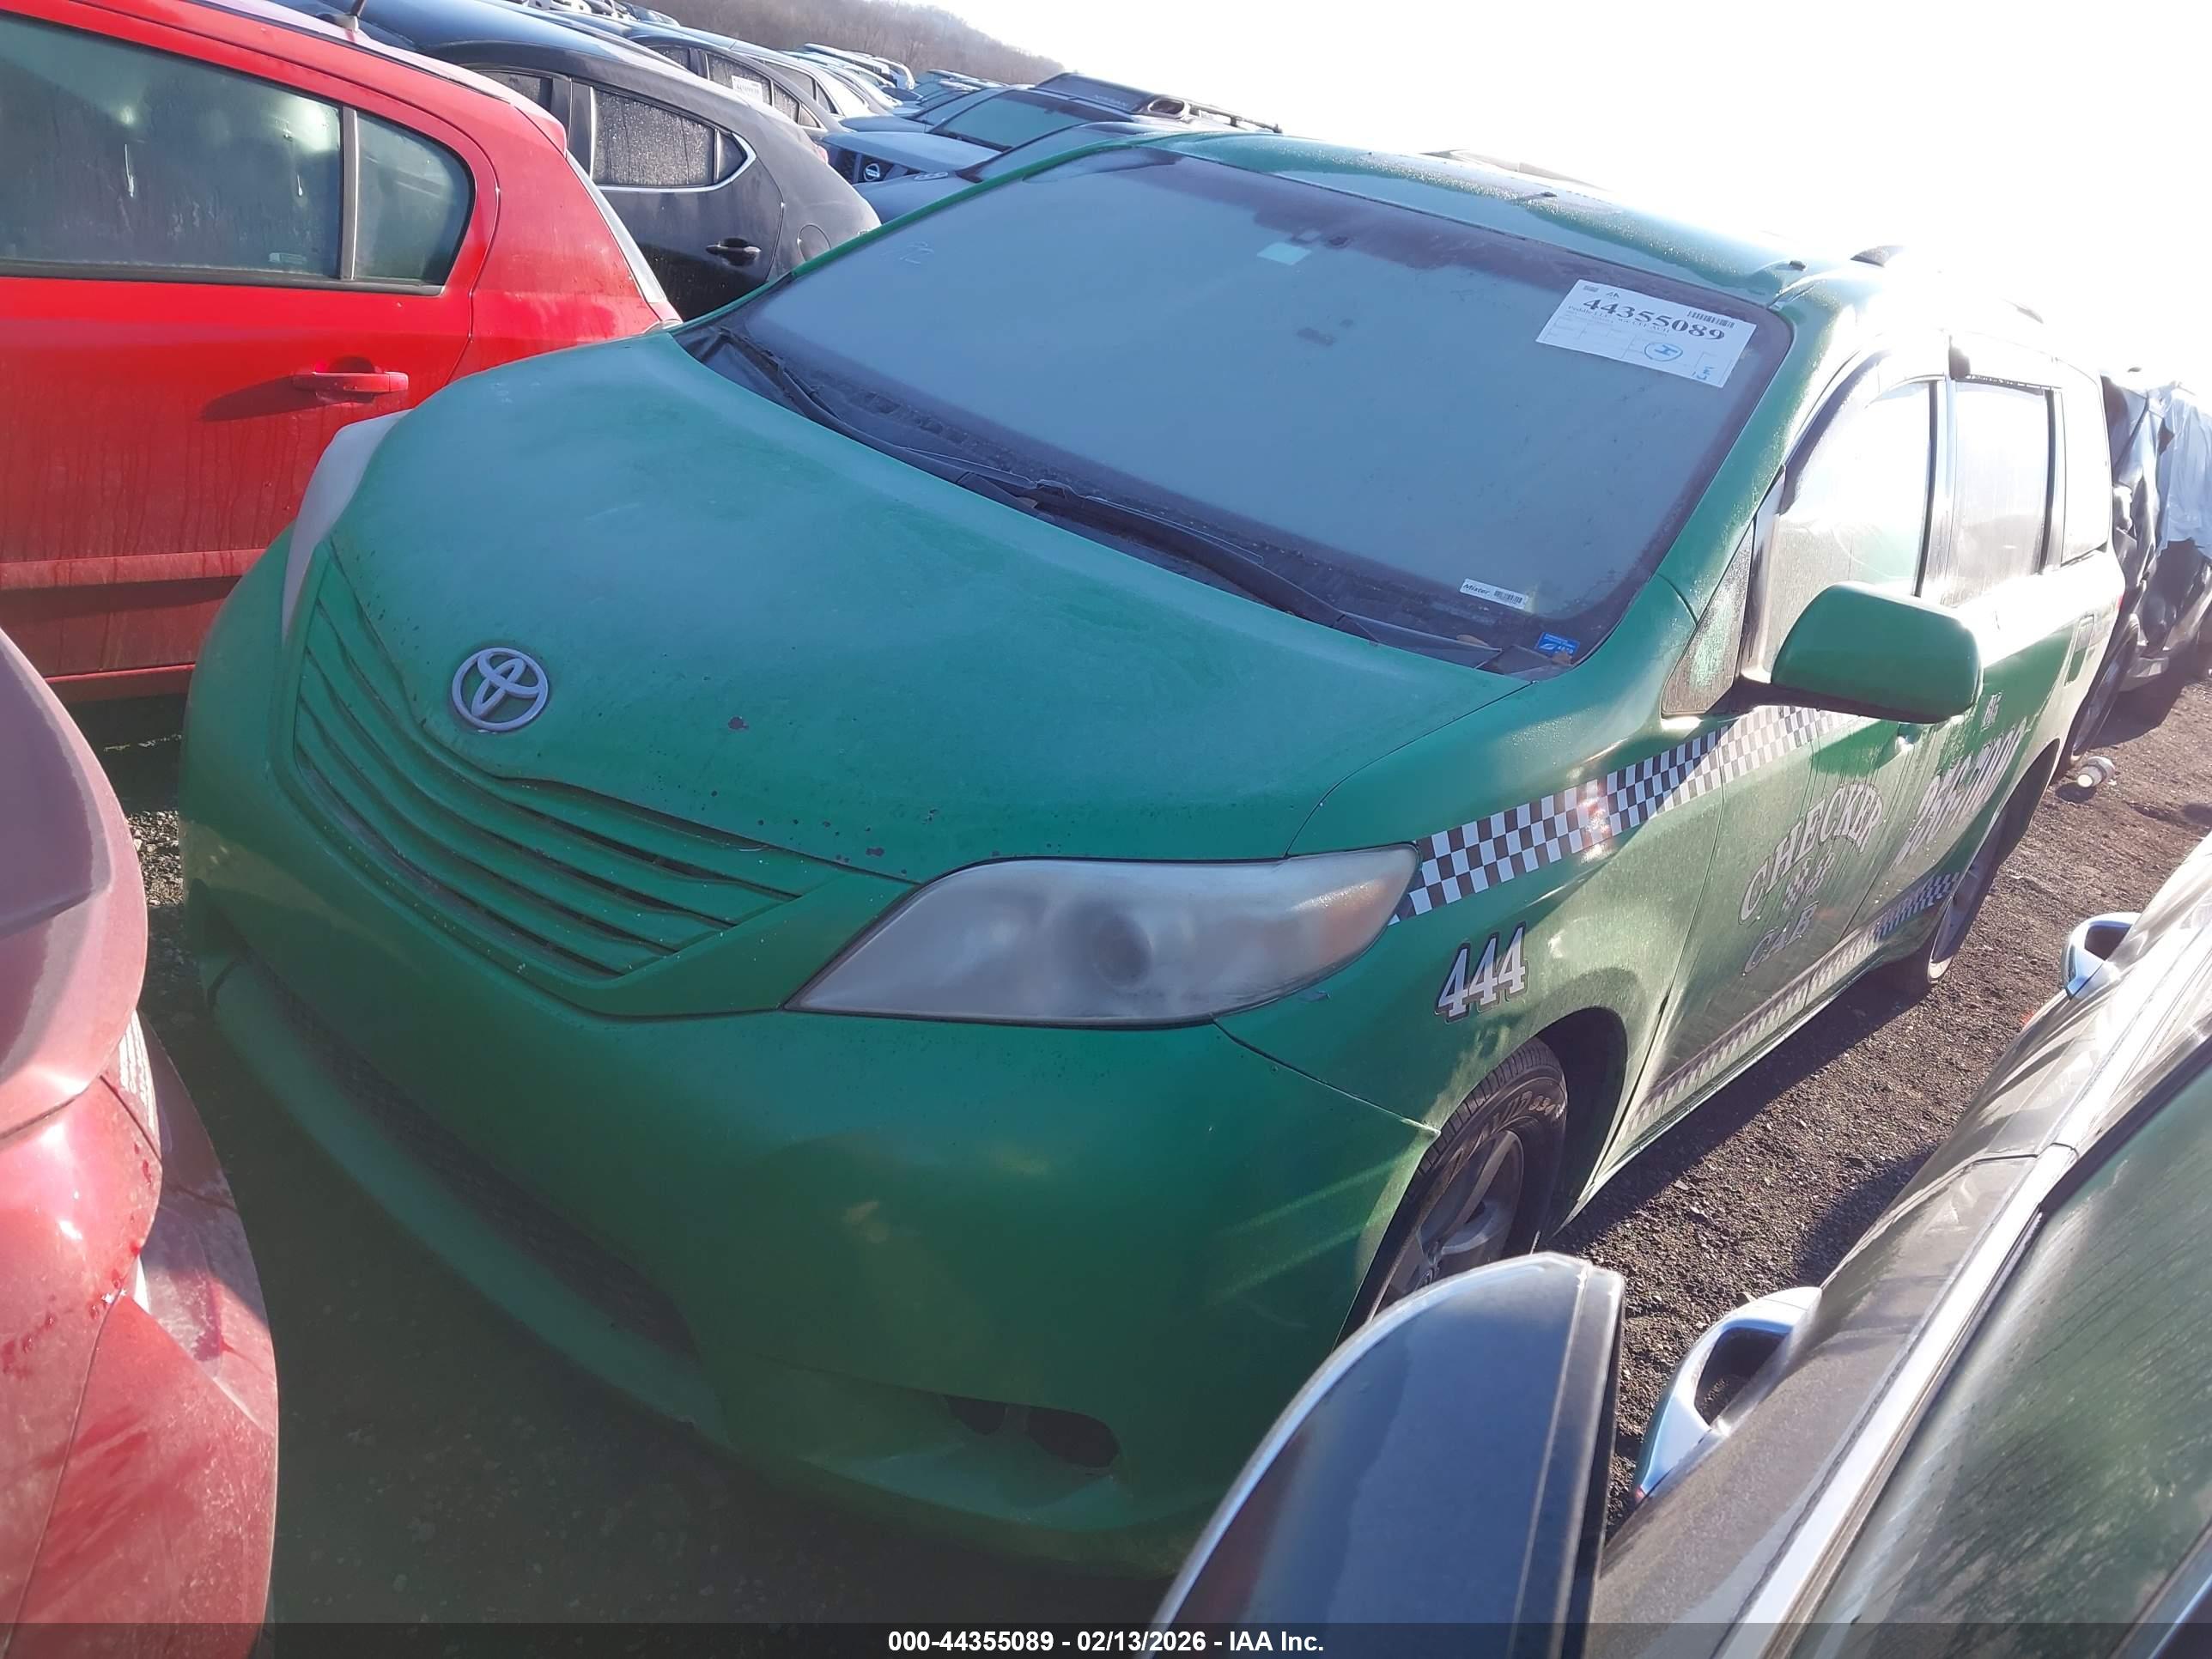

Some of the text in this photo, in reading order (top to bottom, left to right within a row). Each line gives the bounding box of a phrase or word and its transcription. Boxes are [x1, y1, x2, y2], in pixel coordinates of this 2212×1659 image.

[1583, 299, 1725, 340] 44355089
[1737, 782, 1884, 926] CHECKER
[1436, 922, 1527, 1019] 444
[1745, 901, 1819, 975] CAB
